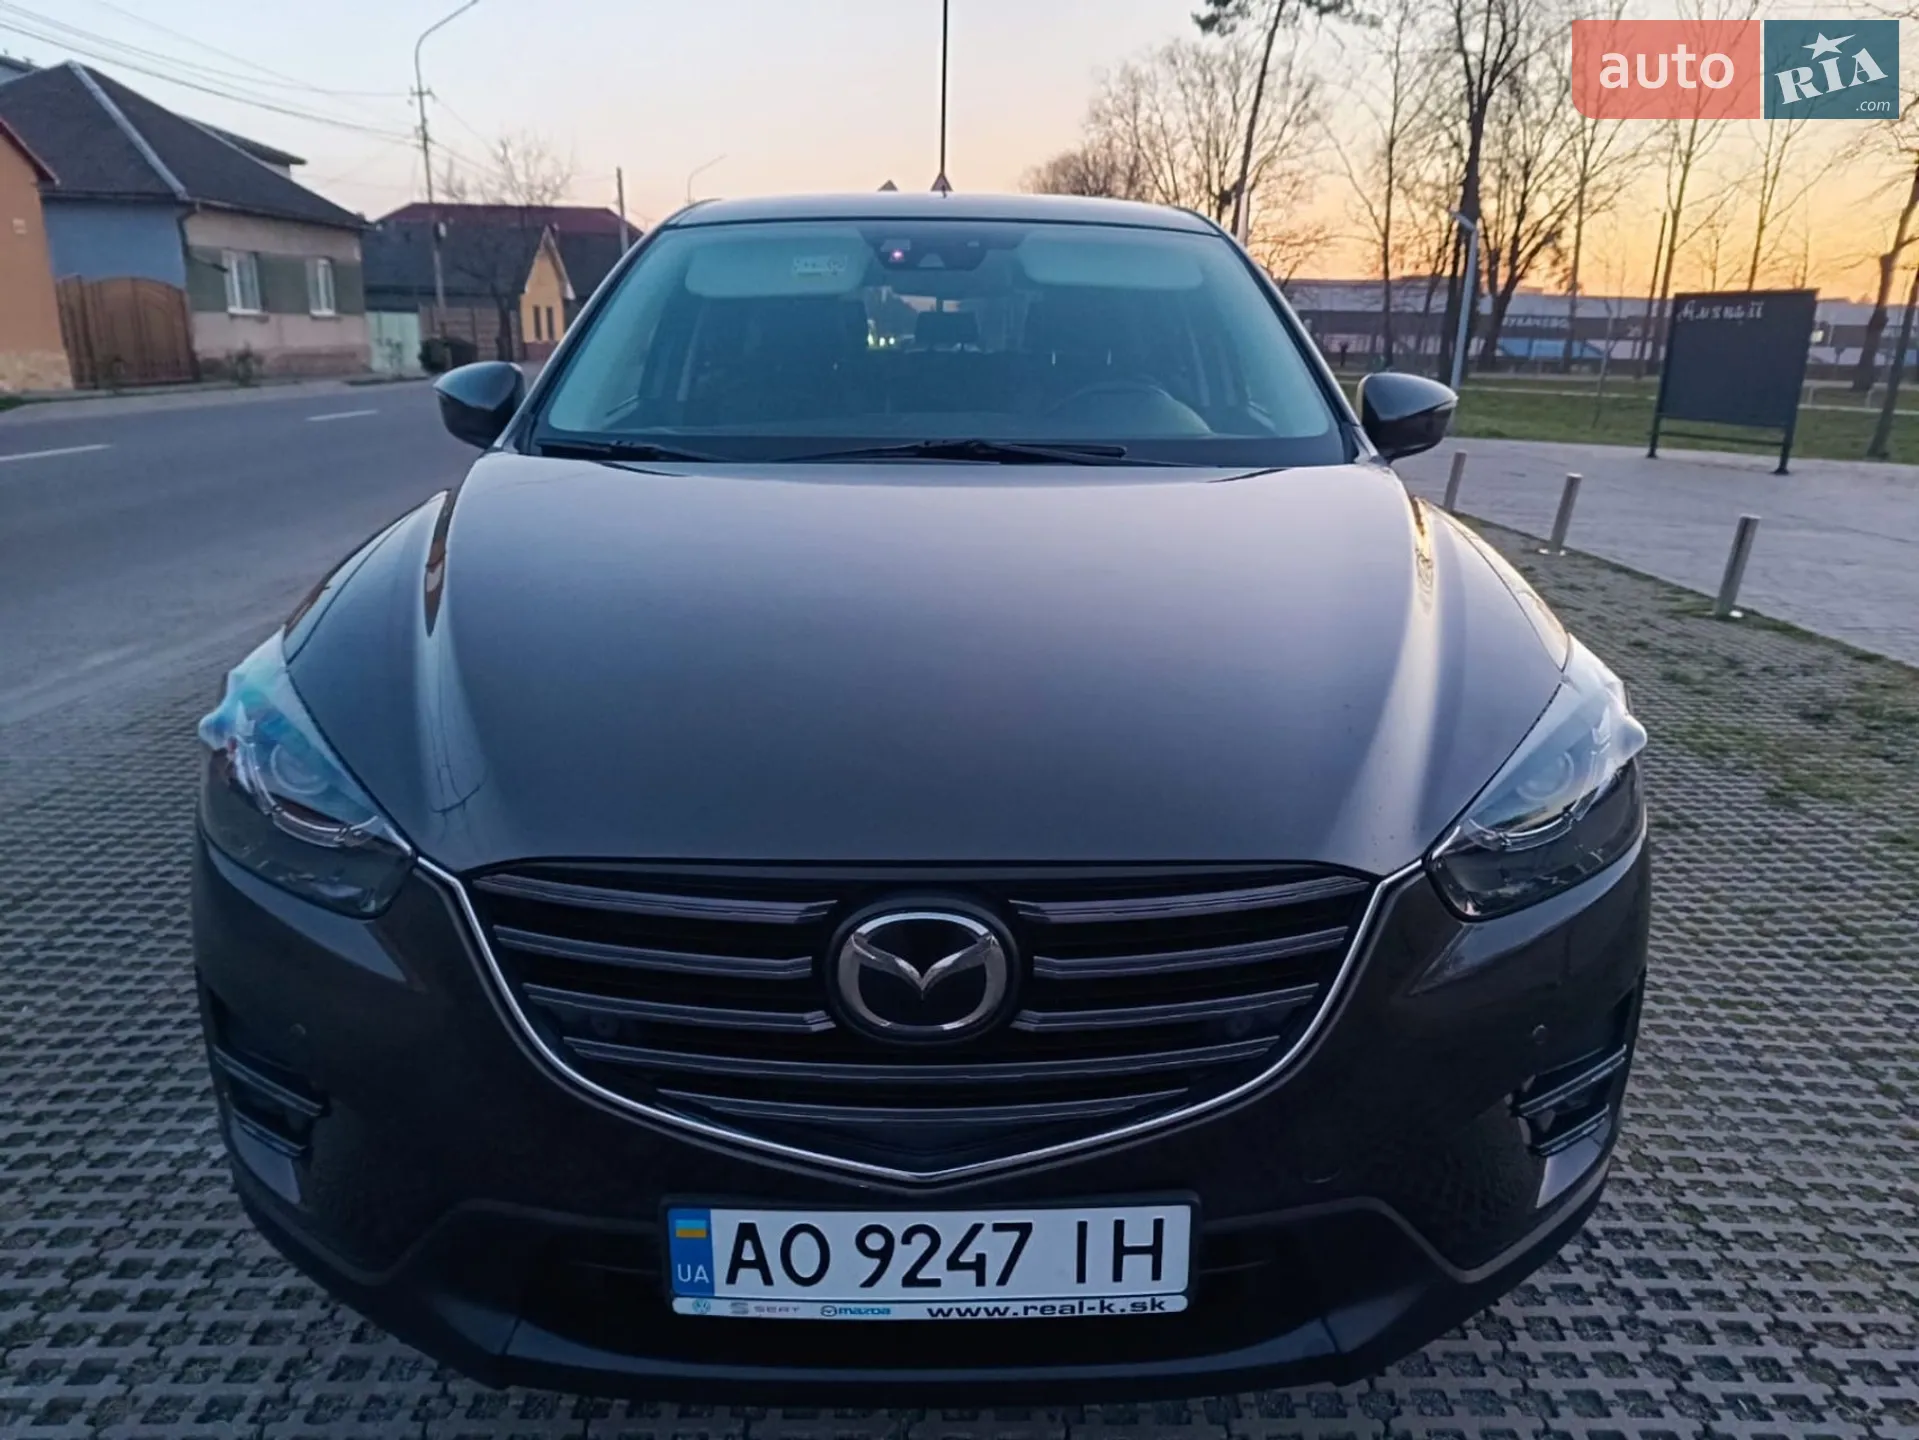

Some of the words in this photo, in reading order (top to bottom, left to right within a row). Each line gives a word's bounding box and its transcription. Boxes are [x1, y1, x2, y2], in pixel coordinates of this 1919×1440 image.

[725, 1222, 831, 1287] AO
[855, 1221, 1034, 1288] 9247
[1075, 1217, 1166, 1284] IH
[677, 1264, 710, 1284] UA
[926, 1297, 1167, 1318] www.real-k.sk
